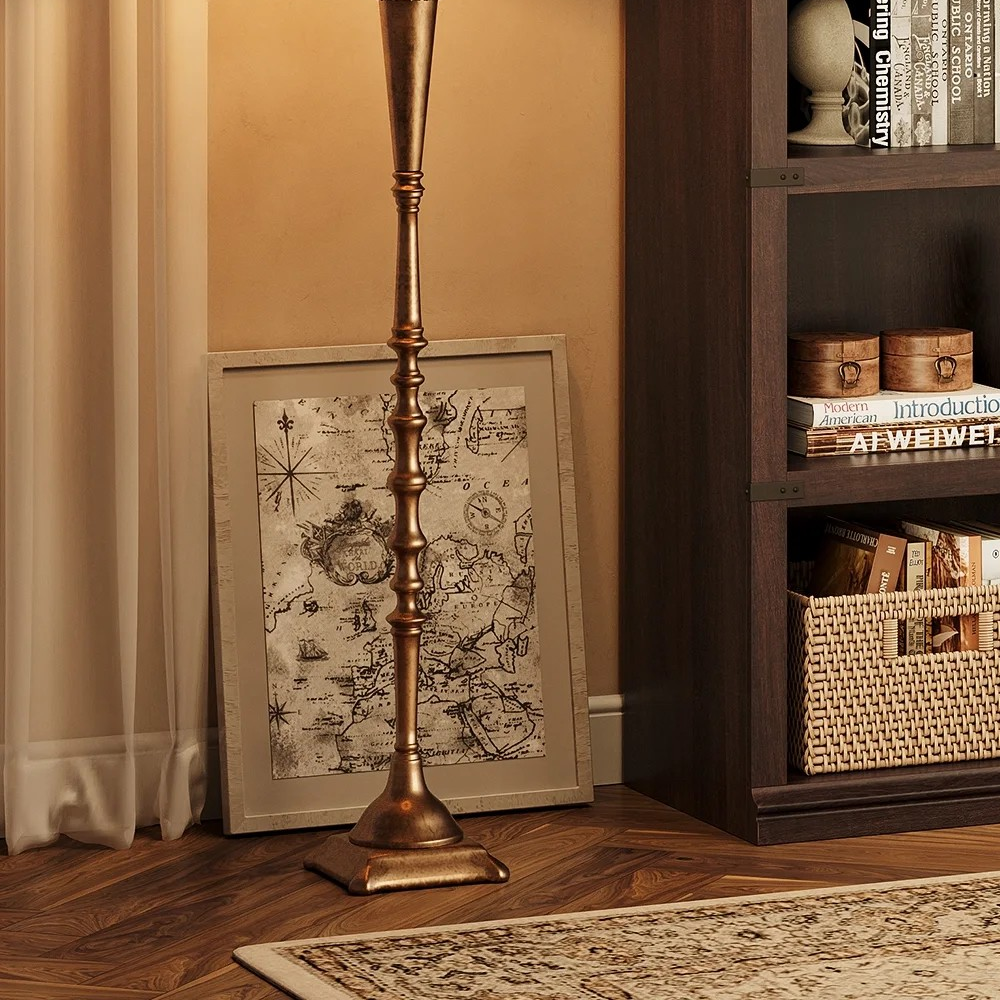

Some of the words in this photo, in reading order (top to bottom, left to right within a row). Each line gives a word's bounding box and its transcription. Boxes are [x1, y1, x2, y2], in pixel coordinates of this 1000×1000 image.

[964, 12, 972, 78] ONTARIO
[872, 50, 890, 146] Chemistry
[931, 51, 939, 106] SCHOOL
[952, 46, 961, 104] SCHOOL
[983, 56, 992, 97] Nation
[819, 413, 877, 426] American
[824, 401, 868, 413] Modern
[850, 433, 879, 453] AI
[887, 424, 995, 451] WEIWEI
